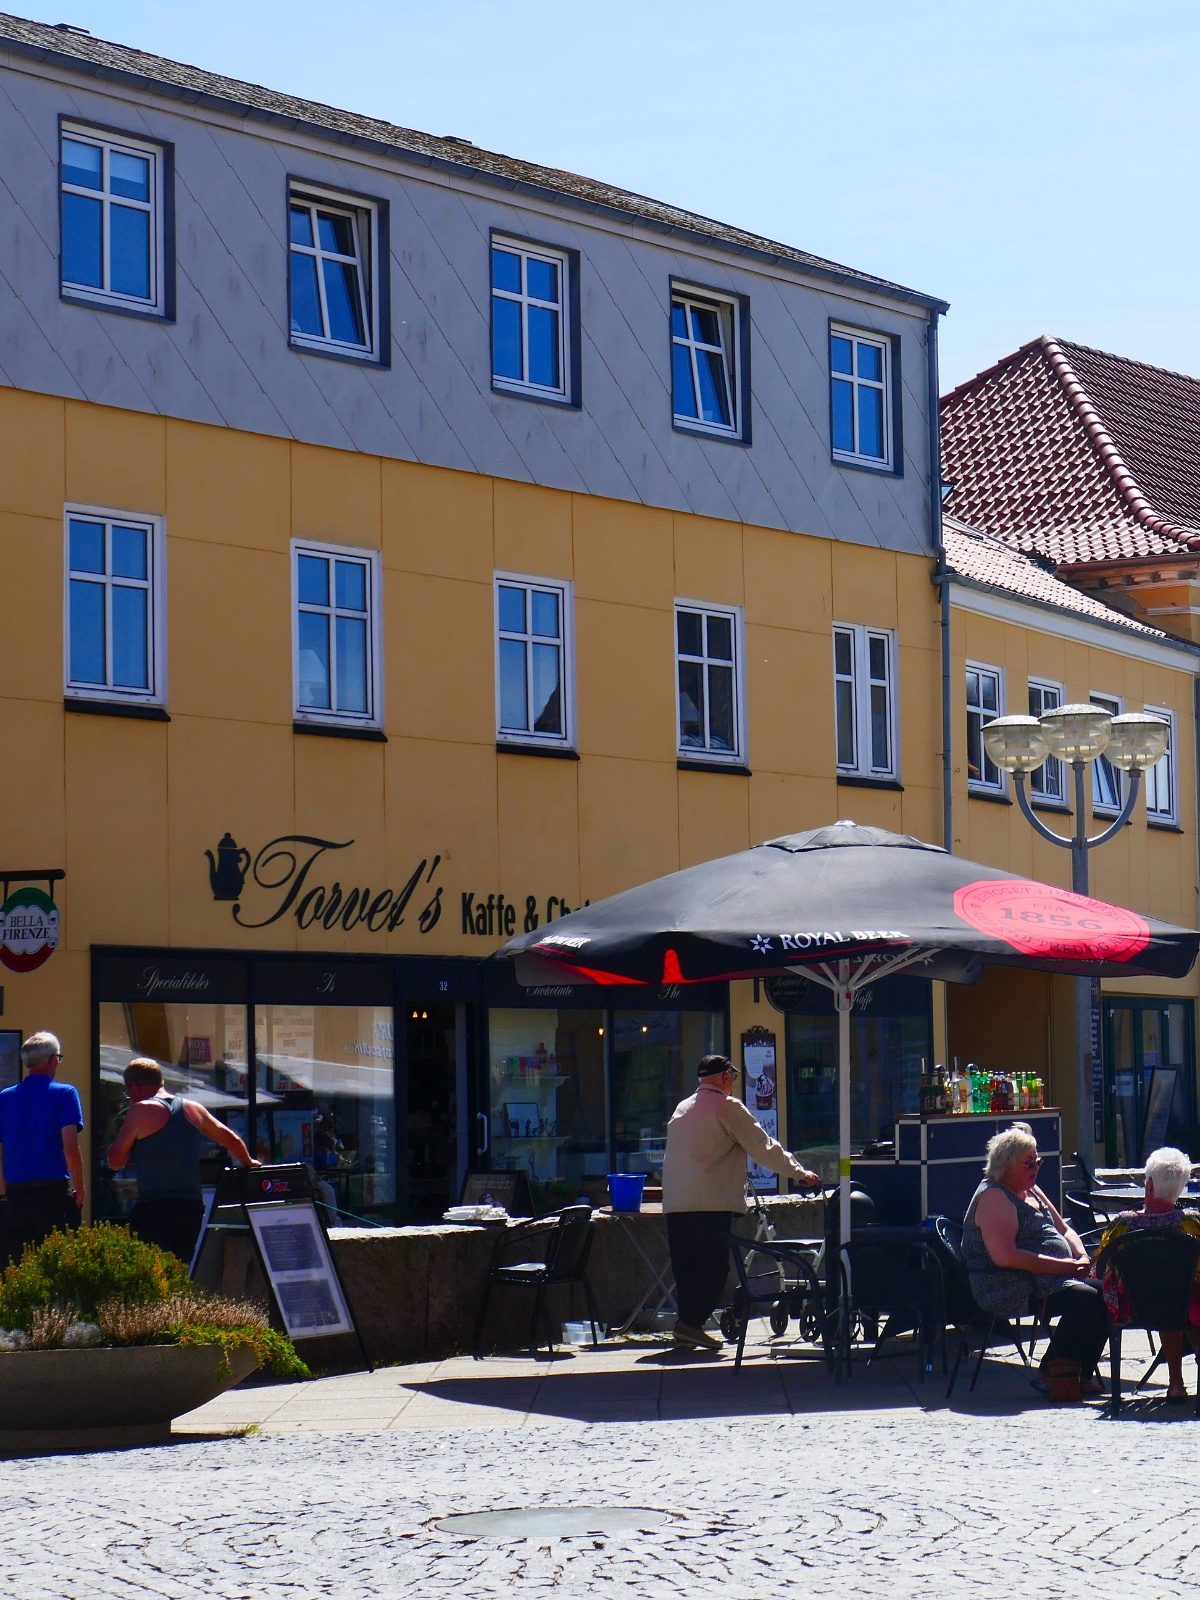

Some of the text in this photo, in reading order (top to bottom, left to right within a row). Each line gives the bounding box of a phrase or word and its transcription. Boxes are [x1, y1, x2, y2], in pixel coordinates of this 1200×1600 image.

[1032, 903, 1065, 912] FRA
[461, 892, 516, 937] Kaffe
[524, 895, 539, 933] &
[1000, 907, 1103, 930] 1856
[10, 915, 44, 928] BELLA
[3, 927, 51, 940] FIRENZE
[779, 930, 911, 950] ROYAL BEER
[439, 980, 448, 992] 32
